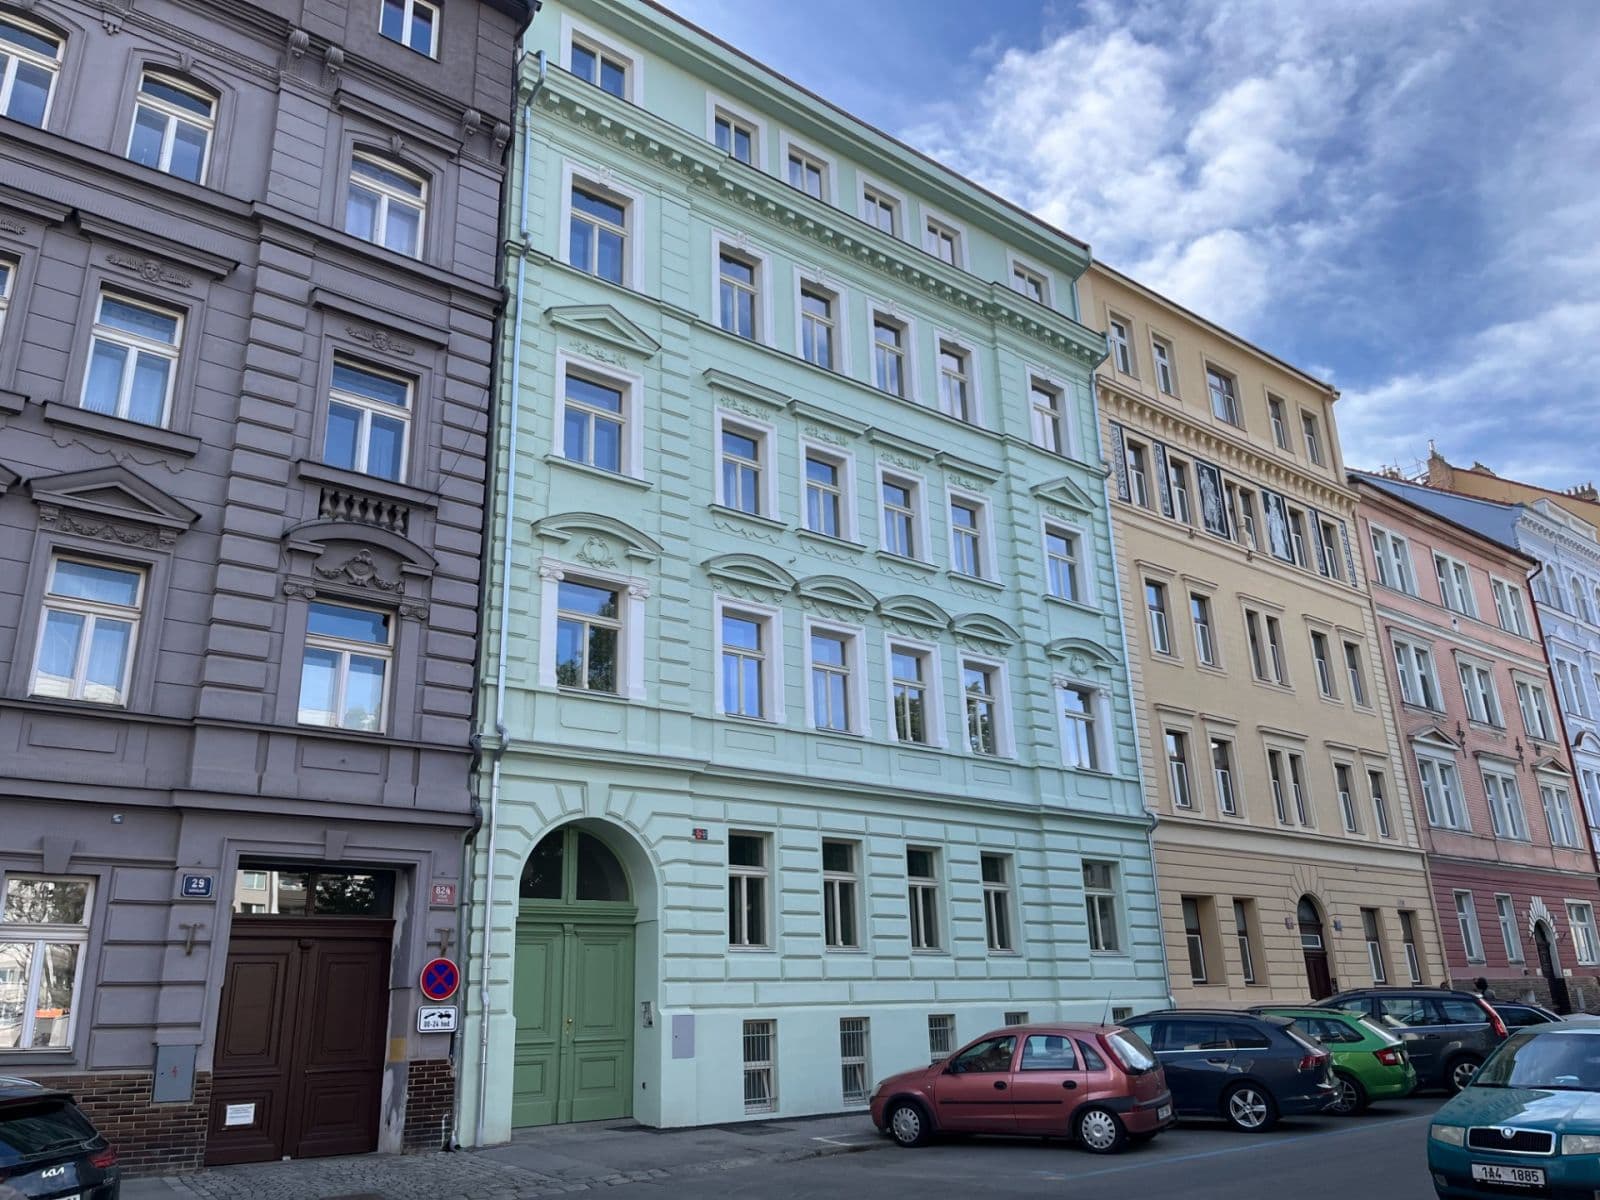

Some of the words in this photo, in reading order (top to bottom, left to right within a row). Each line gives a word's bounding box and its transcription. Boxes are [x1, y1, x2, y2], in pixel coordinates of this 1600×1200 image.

[191, 878, 205, 888] 29
[1481, 1166, 1502, 1180] 1A4
[1511, 1168, 1539, 1182] 1885
